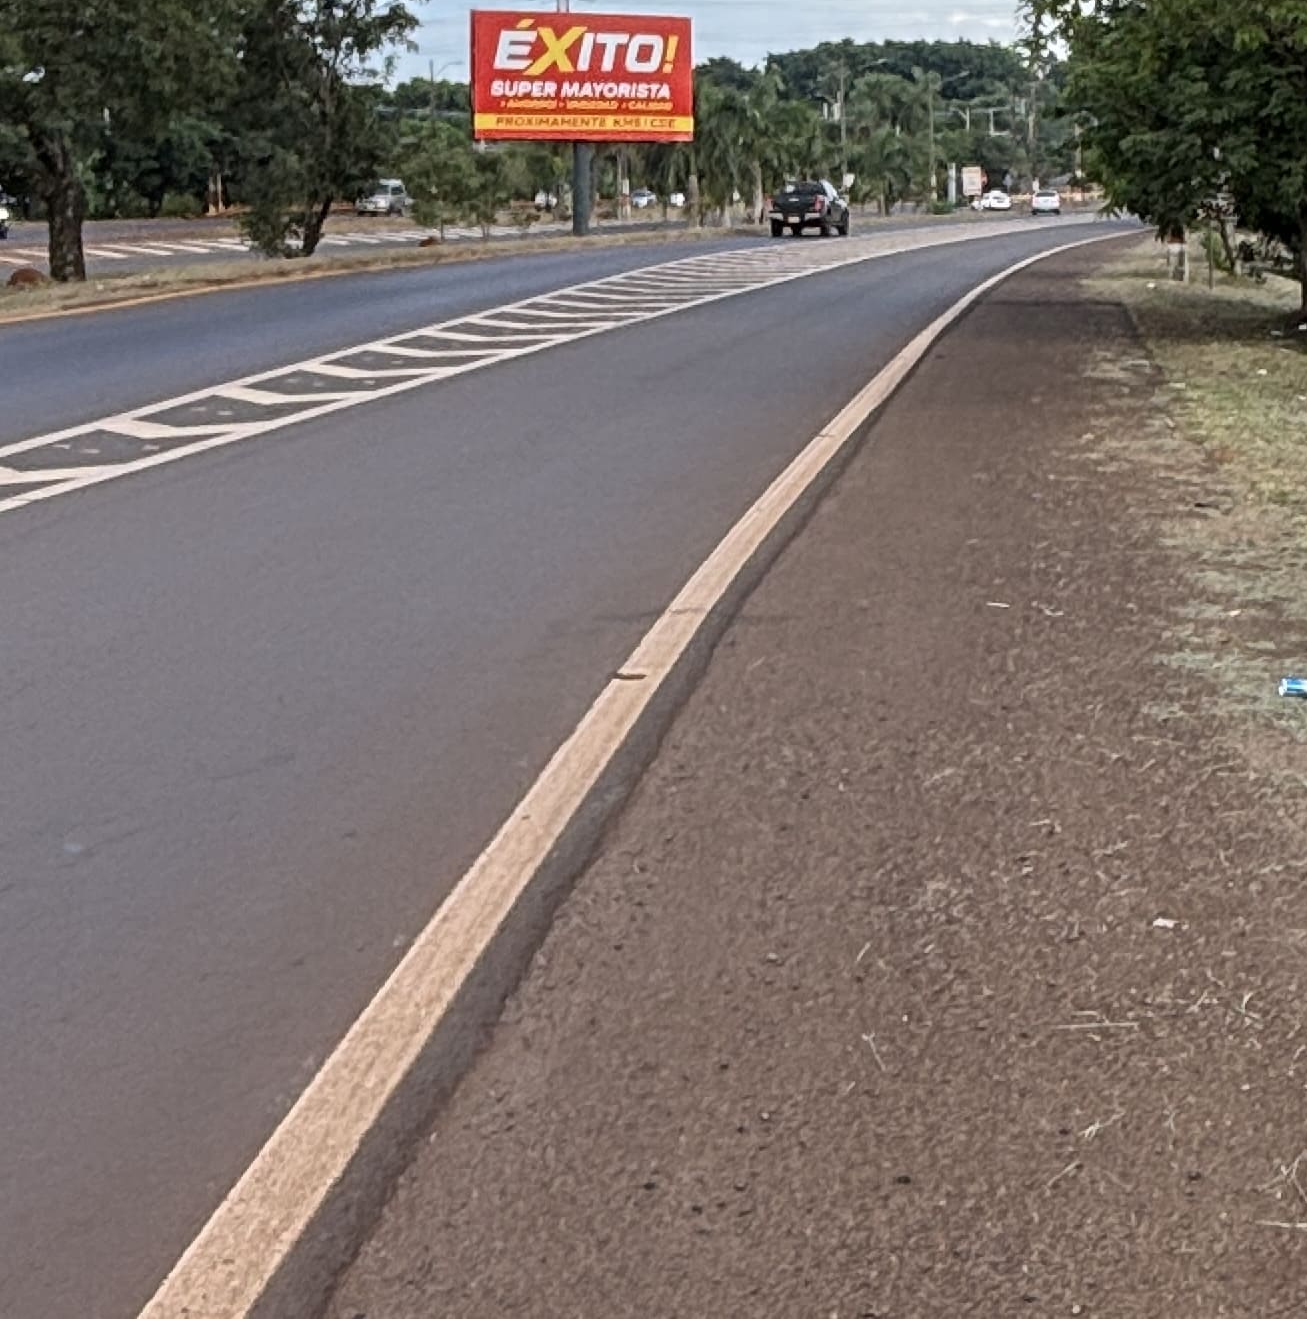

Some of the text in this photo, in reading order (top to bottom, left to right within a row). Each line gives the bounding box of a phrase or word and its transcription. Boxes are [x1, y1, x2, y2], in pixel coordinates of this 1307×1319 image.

[493, 18, 679, 76] ÉXITO!
[490, 80, 671, 99] SUPER MAYORISTA
